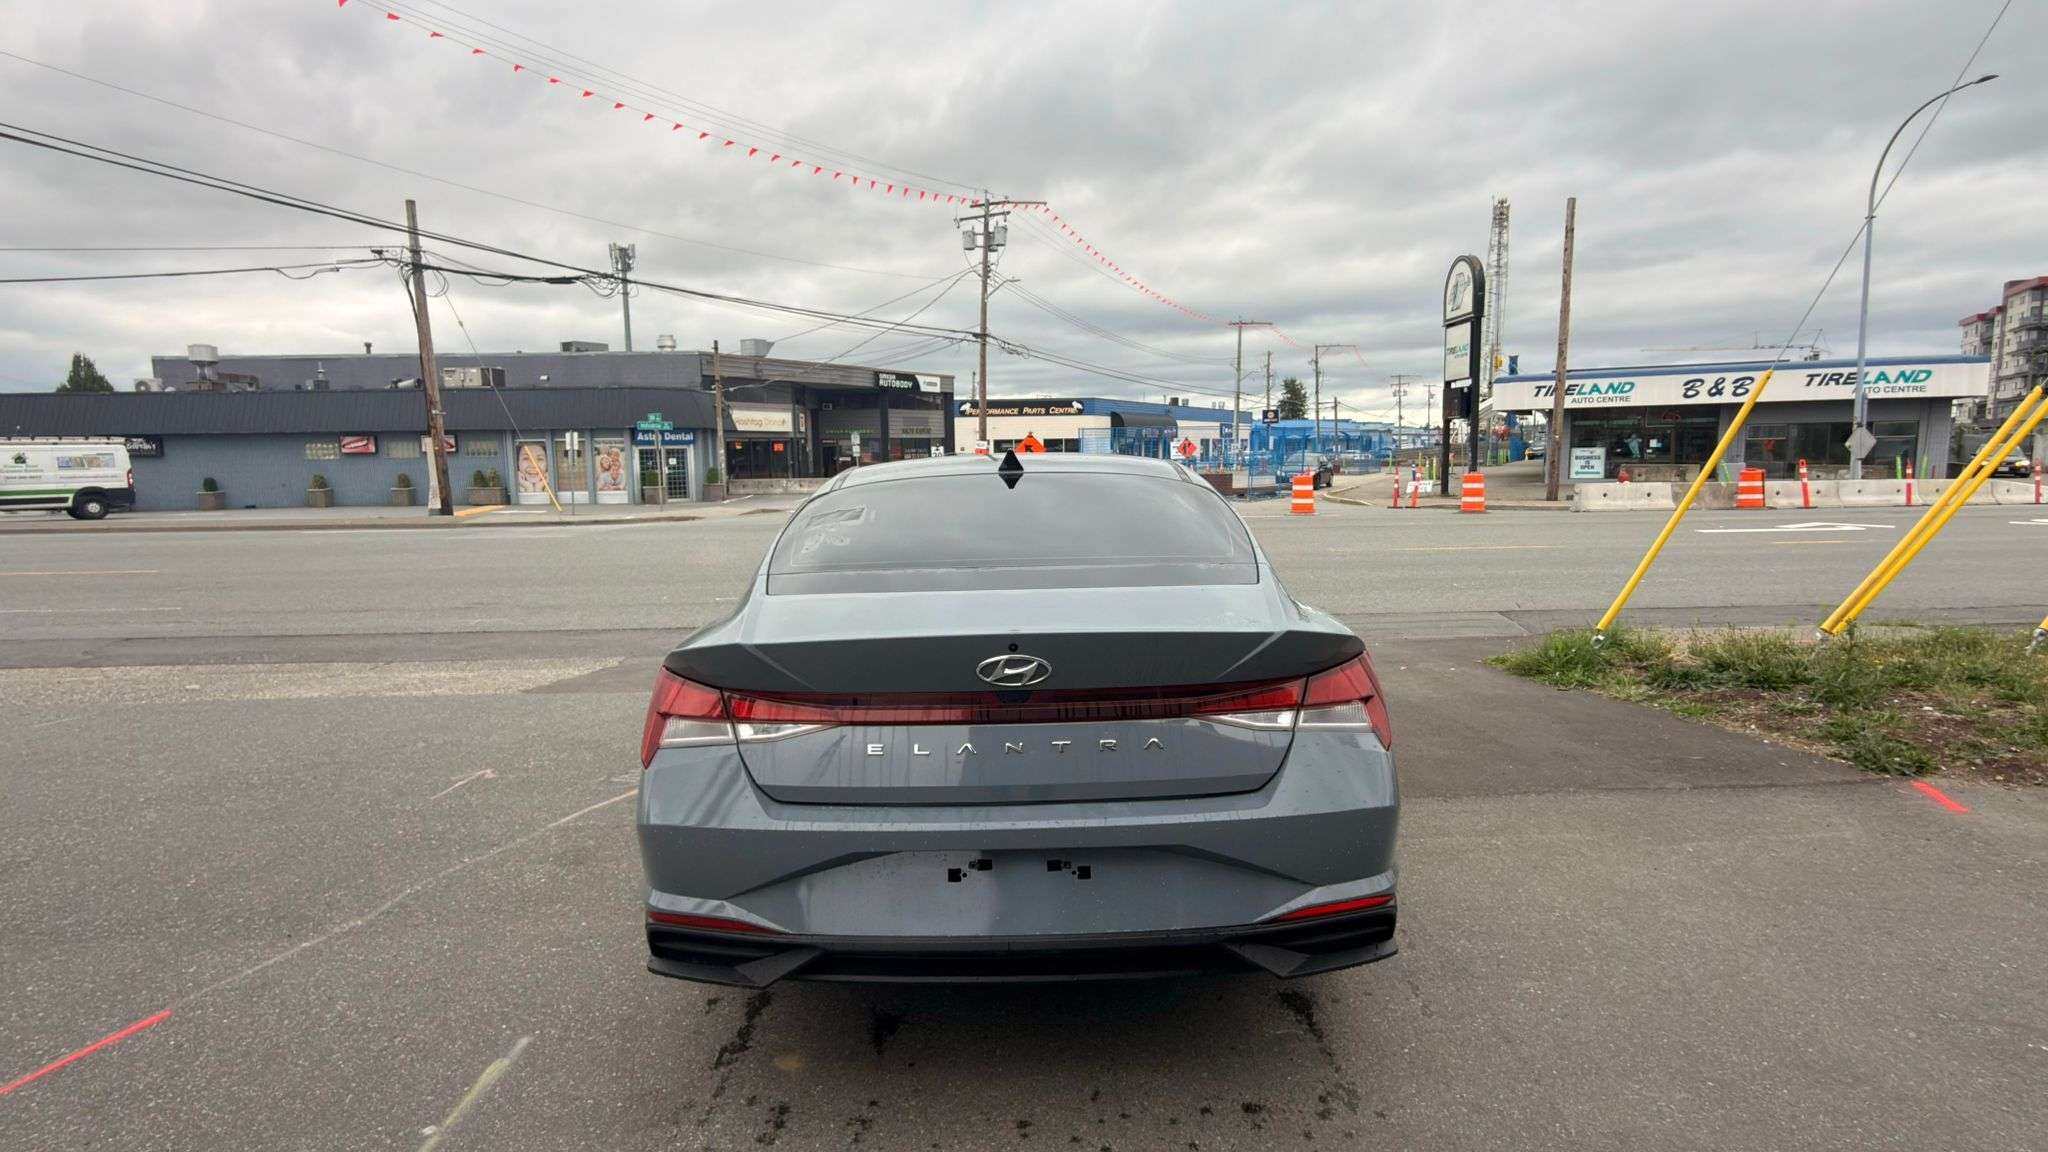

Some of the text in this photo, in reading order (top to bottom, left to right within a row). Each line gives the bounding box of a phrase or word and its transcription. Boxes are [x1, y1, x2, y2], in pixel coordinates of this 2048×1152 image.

[879, 380, 913, 388] AUTOBODY
[1707, 377, 1726, 397] &
[1883, 385, 1927, 393] CENTRE
[664, 432, 694, 440] Dental
[866, 737, 1164, 756] ELANTRA
